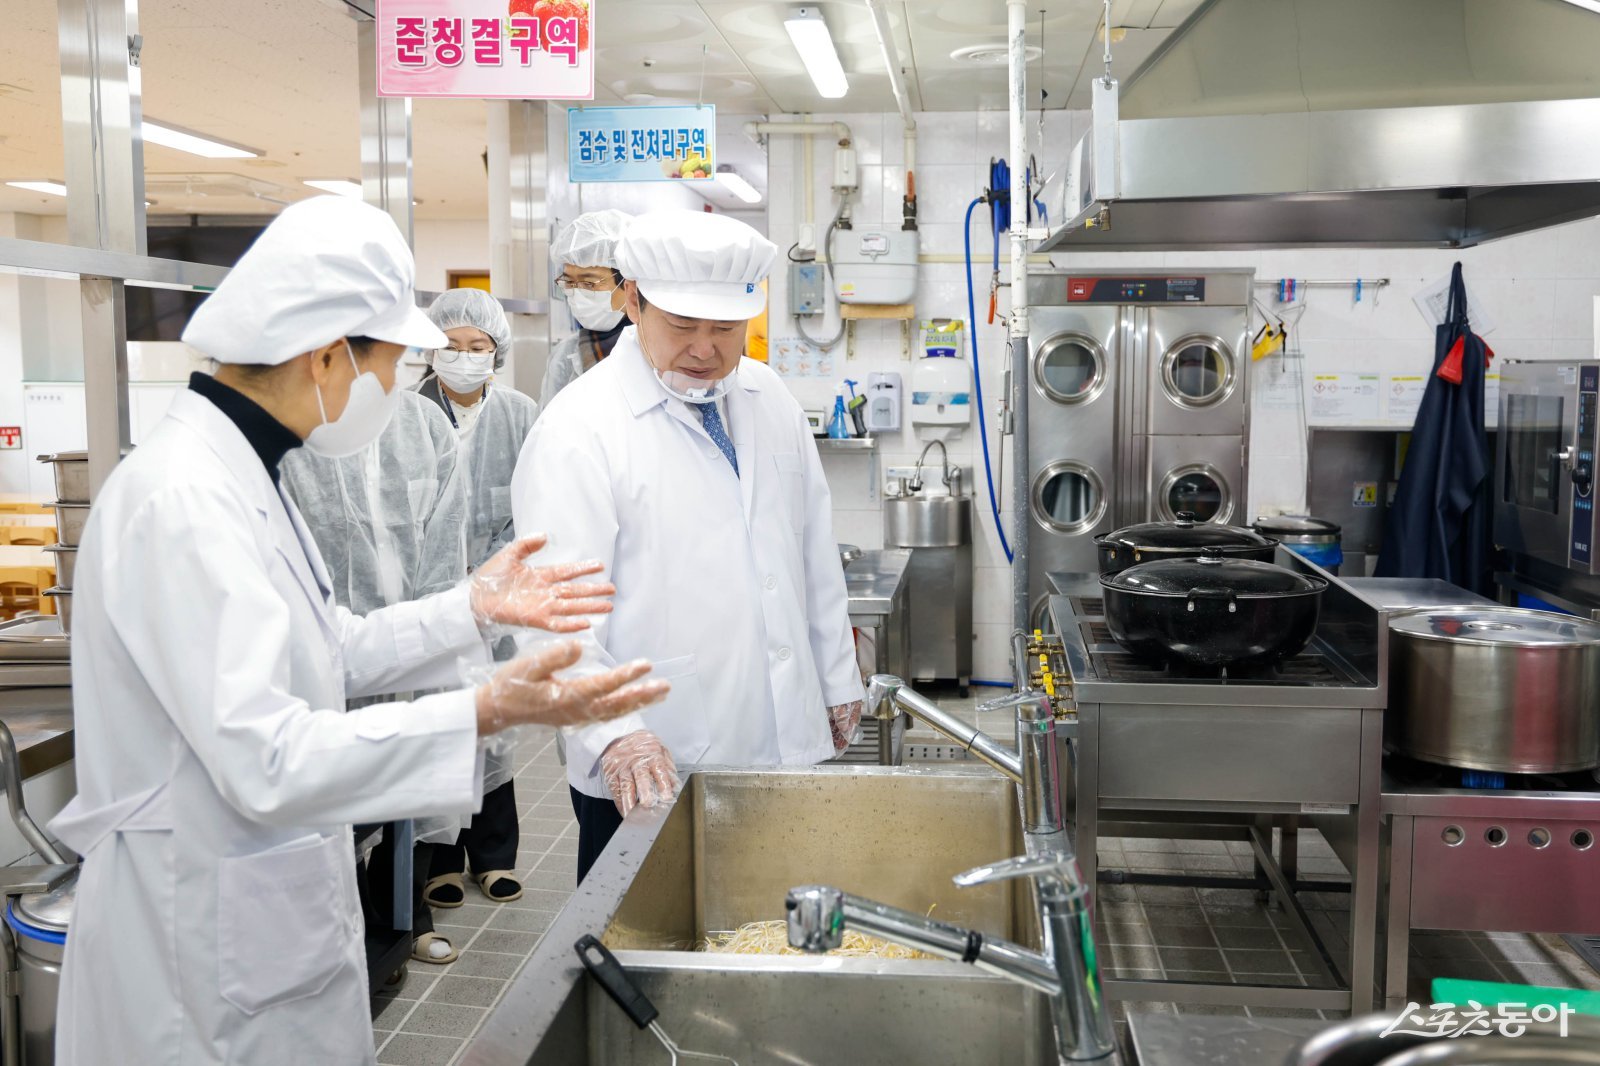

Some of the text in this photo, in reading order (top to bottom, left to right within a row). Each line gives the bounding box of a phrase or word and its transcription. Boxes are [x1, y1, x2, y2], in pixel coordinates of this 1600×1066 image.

[395, 16, 579, 66] 준청결구역
[578, 128, 706, 161] 검수 및 전처리구역
